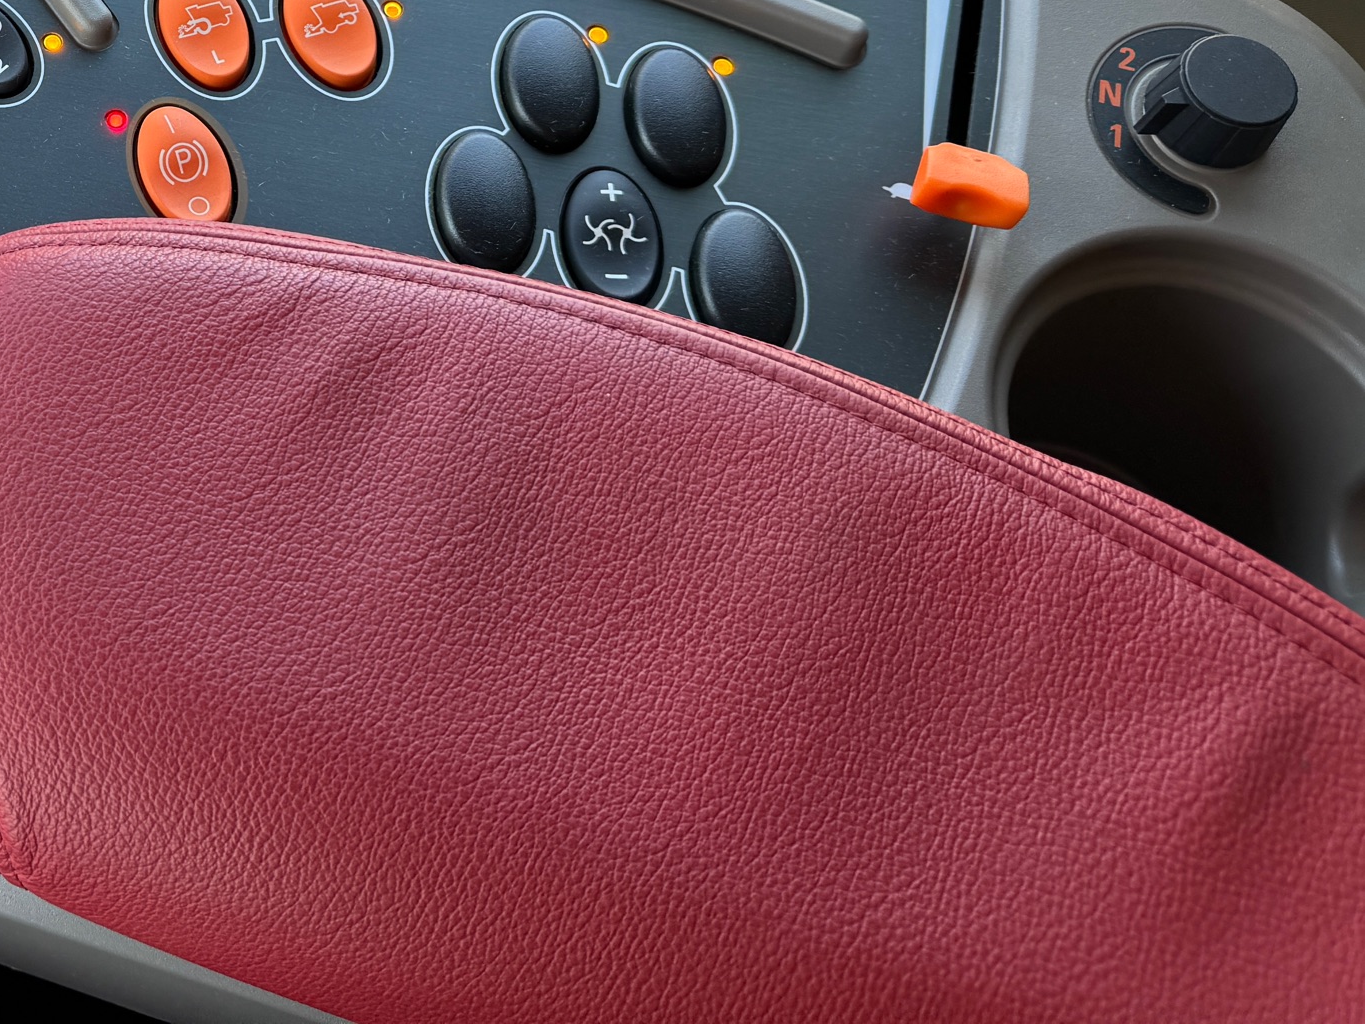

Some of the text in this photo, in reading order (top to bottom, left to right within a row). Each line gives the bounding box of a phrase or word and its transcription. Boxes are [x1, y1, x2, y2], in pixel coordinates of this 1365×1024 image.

[211, 50, 225, 65] L
[1118, 47, 1136, 71] 2
[1098, 79, 1122, 107] N
[1109, 124, 1122, 148] 1
[175, 148, 191, 174] P
